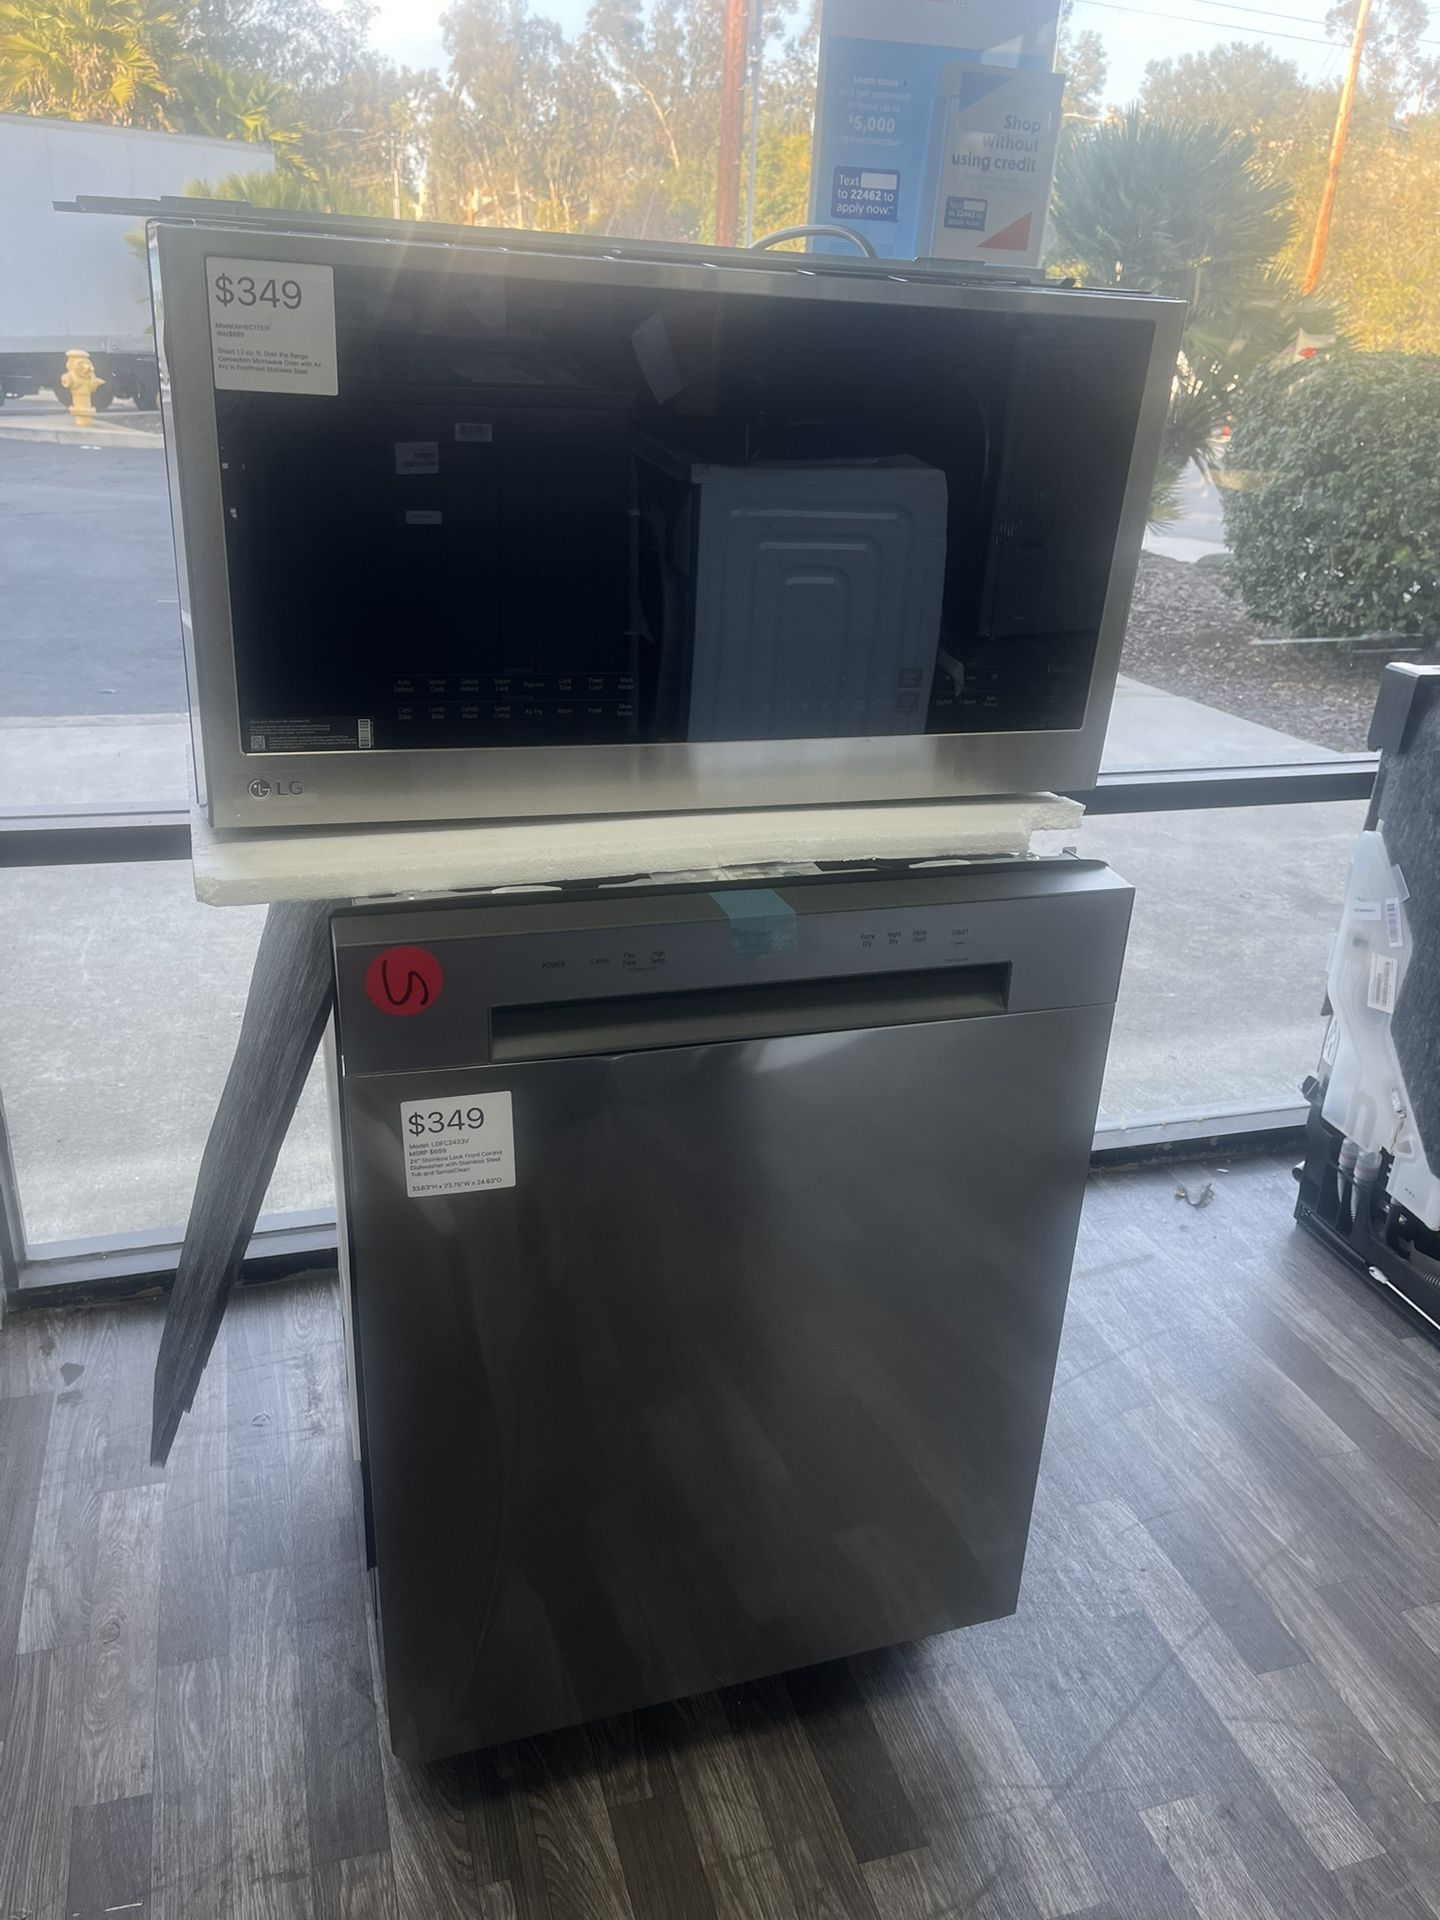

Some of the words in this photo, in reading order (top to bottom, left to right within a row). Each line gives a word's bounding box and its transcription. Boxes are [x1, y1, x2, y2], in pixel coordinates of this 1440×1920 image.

[848, 114, 896, 134] $5,000
[1003, 114, 1041, 134] Shop
[983, 134, 1039, 152] without
[951, 151, 991, 172] using
[993, 156, 1036, 173] credit
[839, 174, 859, 186] Text
[837, 189, 848, 199] to
[850, 188, 881, 201] 22462
[883, 191, 894, 202] to
[836, 202, 864, 215] apply
[215, 272, 302, 310] $349
[276, 781, 304, 796] LG
[408, 1107, 485, 1137] $349
[409, 1149, 428, 1157] MSRP
[481, 1149, 503, 1157] Control
[410, 1163, 444, 1171] Dishwasher
